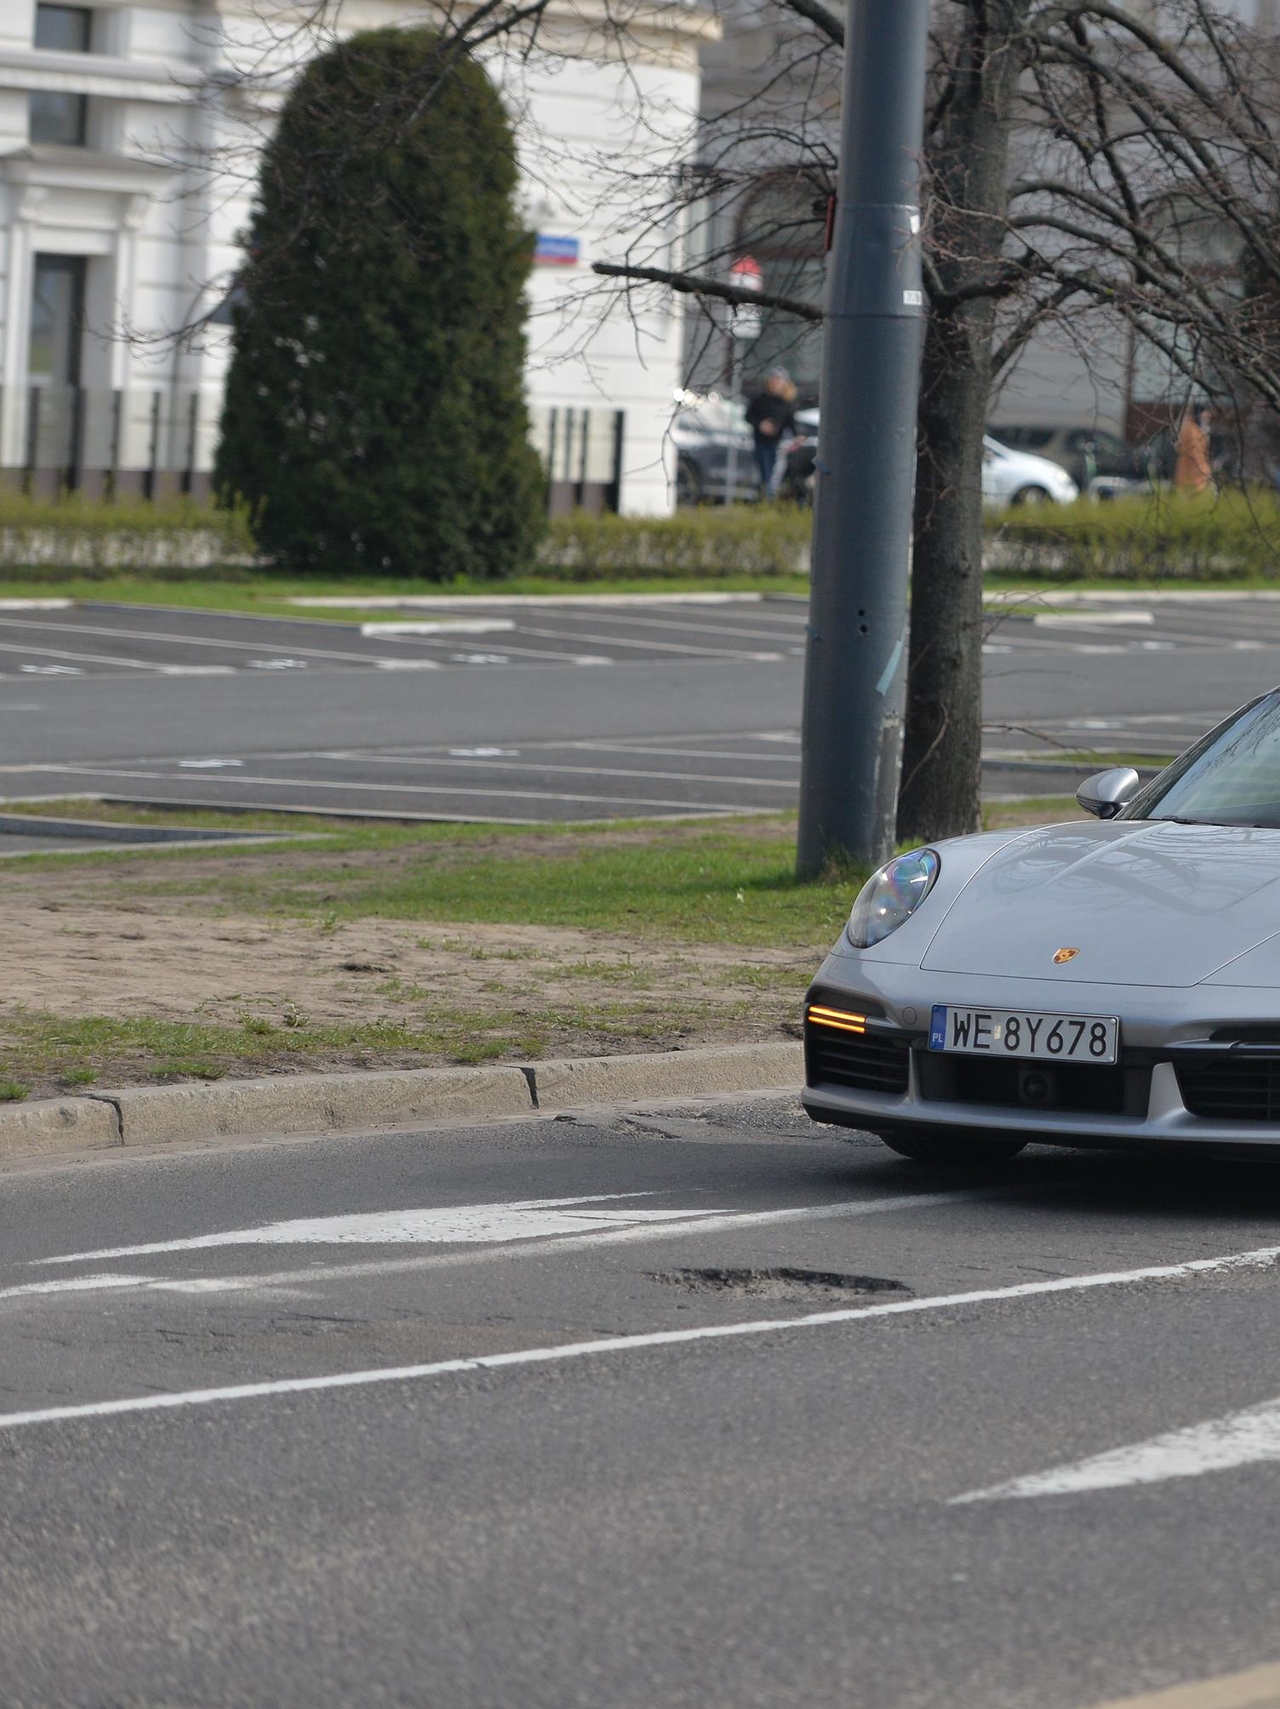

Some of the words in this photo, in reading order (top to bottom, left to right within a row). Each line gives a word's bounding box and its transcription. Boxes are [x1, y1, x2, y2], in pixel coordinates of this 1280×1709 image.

[932, 1032, 943, 1043] PL
[953, 1012, 992, 1049] WE
[1003, 1016, 1107, 1057] 8Y678
